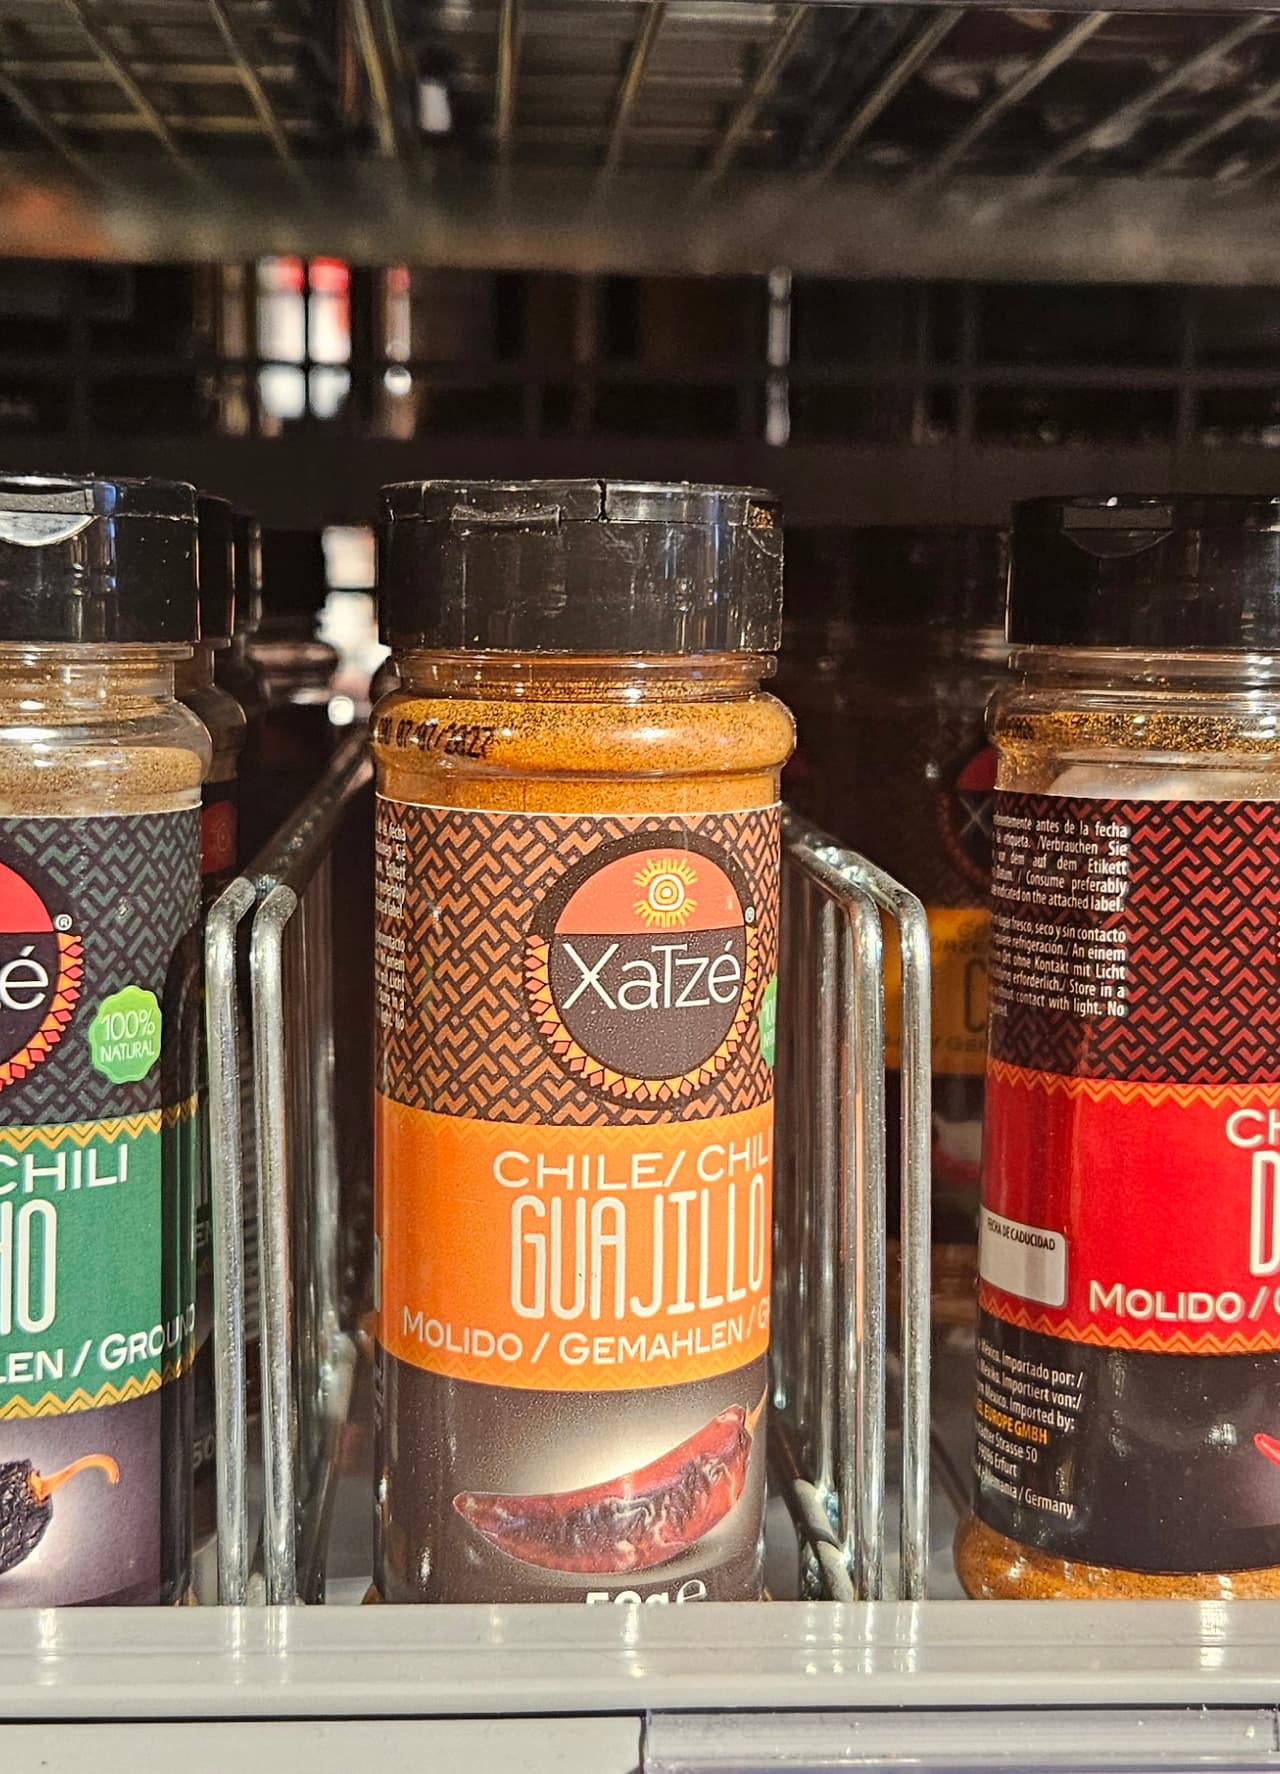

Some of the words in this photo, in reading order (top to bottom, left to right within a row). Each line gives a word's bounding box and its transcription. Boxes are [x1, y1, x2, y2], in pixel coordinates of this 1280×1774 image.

[1035, 818, 1060, 833] antes
[1064, 818, 1076, 835] de
[1080, 820, 1089, 836] la
[1095, 820, 1129, 838] fecha
[1108, 840, 1128, 857] Sie
[1056, 855, 1078, 871] dem
[1088, 858, 1128, 876] Etikett
[1026, 869, 1065, 888] Consume
[1071, 876, 1129, 898] preferably
[1033, 889, 1047, 905] the
[1048, 892, 1090, 910] attached
[1090, 896, 1125, 913] label.
[1062, 924, 1076, 939] sin
[1077, 928, 1127, 944] contacto
[1072, 942, 1085, 959] An
[1088, 944, 1126, 961] einem
[1034, 955, 1070, 975] Kontakt
[1073, 962, 1090, 978] mit
[1096, 963, 1126, 981] Licht
[1069, 978, 1097, 997] Store
[1100, 981, 1113, 998] in
[1116, 985, 1125, 998] a
[1048, 993, 1070, 1011] with
[1073, 996, 1103, 1018] light.
[1107, 1000, 1126, 1017] No
[100, 1011, 156, 1041] 100%
[100, 1040, 155, 1062] NATURAL
[510, 1173, 765, 1320] GUAJILLO
[1010, 1227, 1056, 1251] CADUCIDAD
[1089, 1279, 1242, 1324] MOLIDO
[98, 1302, 196, 1368] GROUND
[402, 1305, 523, 1363] MOLIDO
[559, 1320, 743, 1366] GEMAHLEN
[1051, 1369, 1075, 1387] por:
[1009, 1396, 1055, 1426] Imported
[1056, 1410, 1076, 1433] by:
[1014, 1419, 1048, 1446] GMBH
[994, 1452, 1018, 1478] Erfurt
[1025, 1445, 1039, 1464] 50
[1024, 1487, 1075, 1520] Germany
